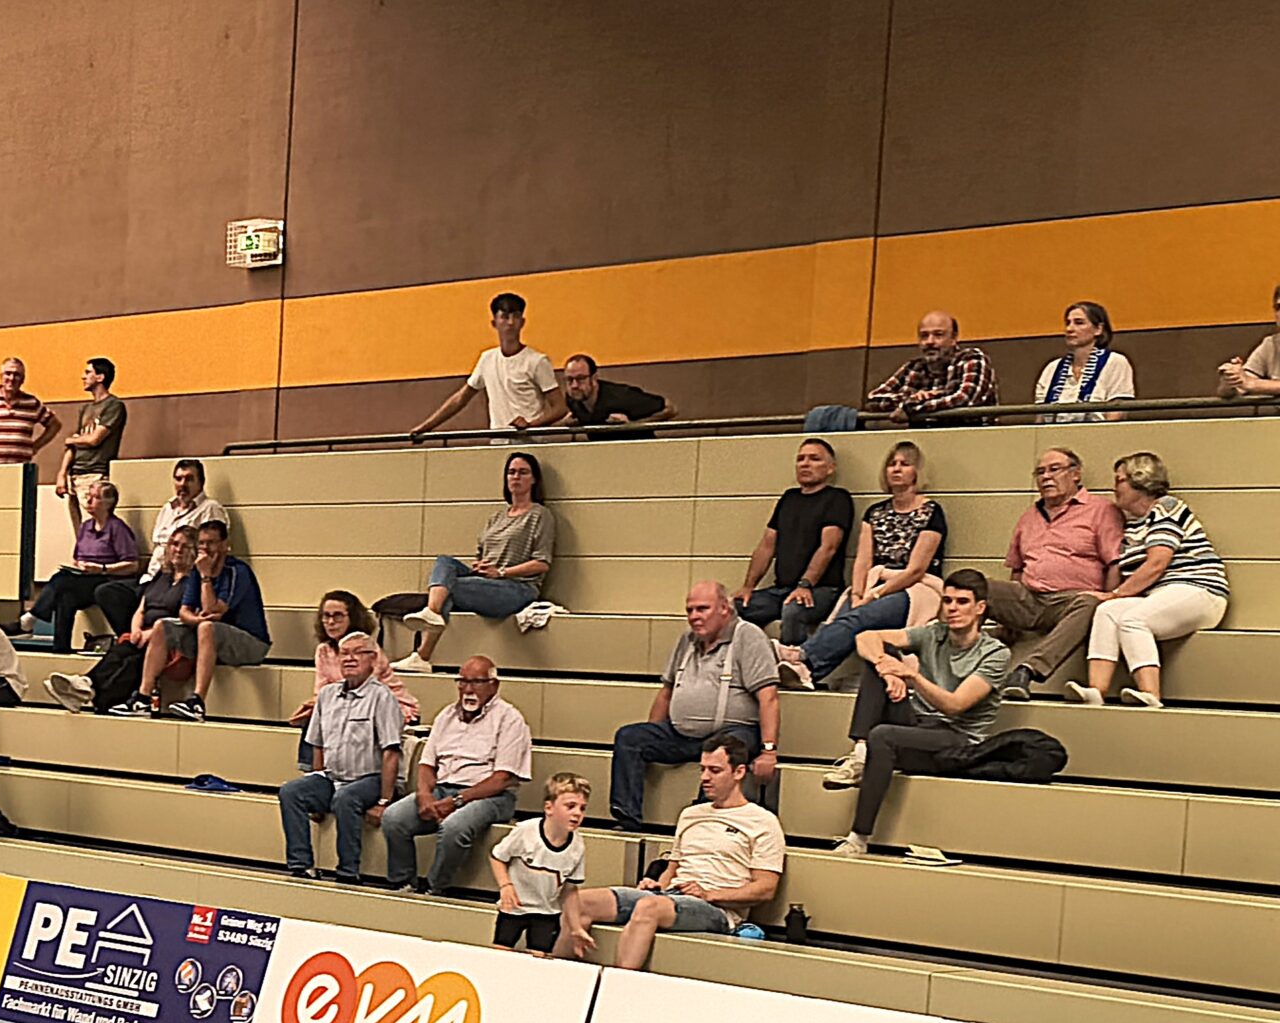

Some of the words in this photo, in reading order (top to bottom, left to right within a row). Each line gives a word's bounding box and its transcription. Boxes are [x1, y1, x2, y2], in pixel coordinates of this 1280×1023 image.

[21, 902, 98, 969] PE
[104, 964, 158, 992] SINZIG
[1, 994, 52, 1018] Fachmarkt
